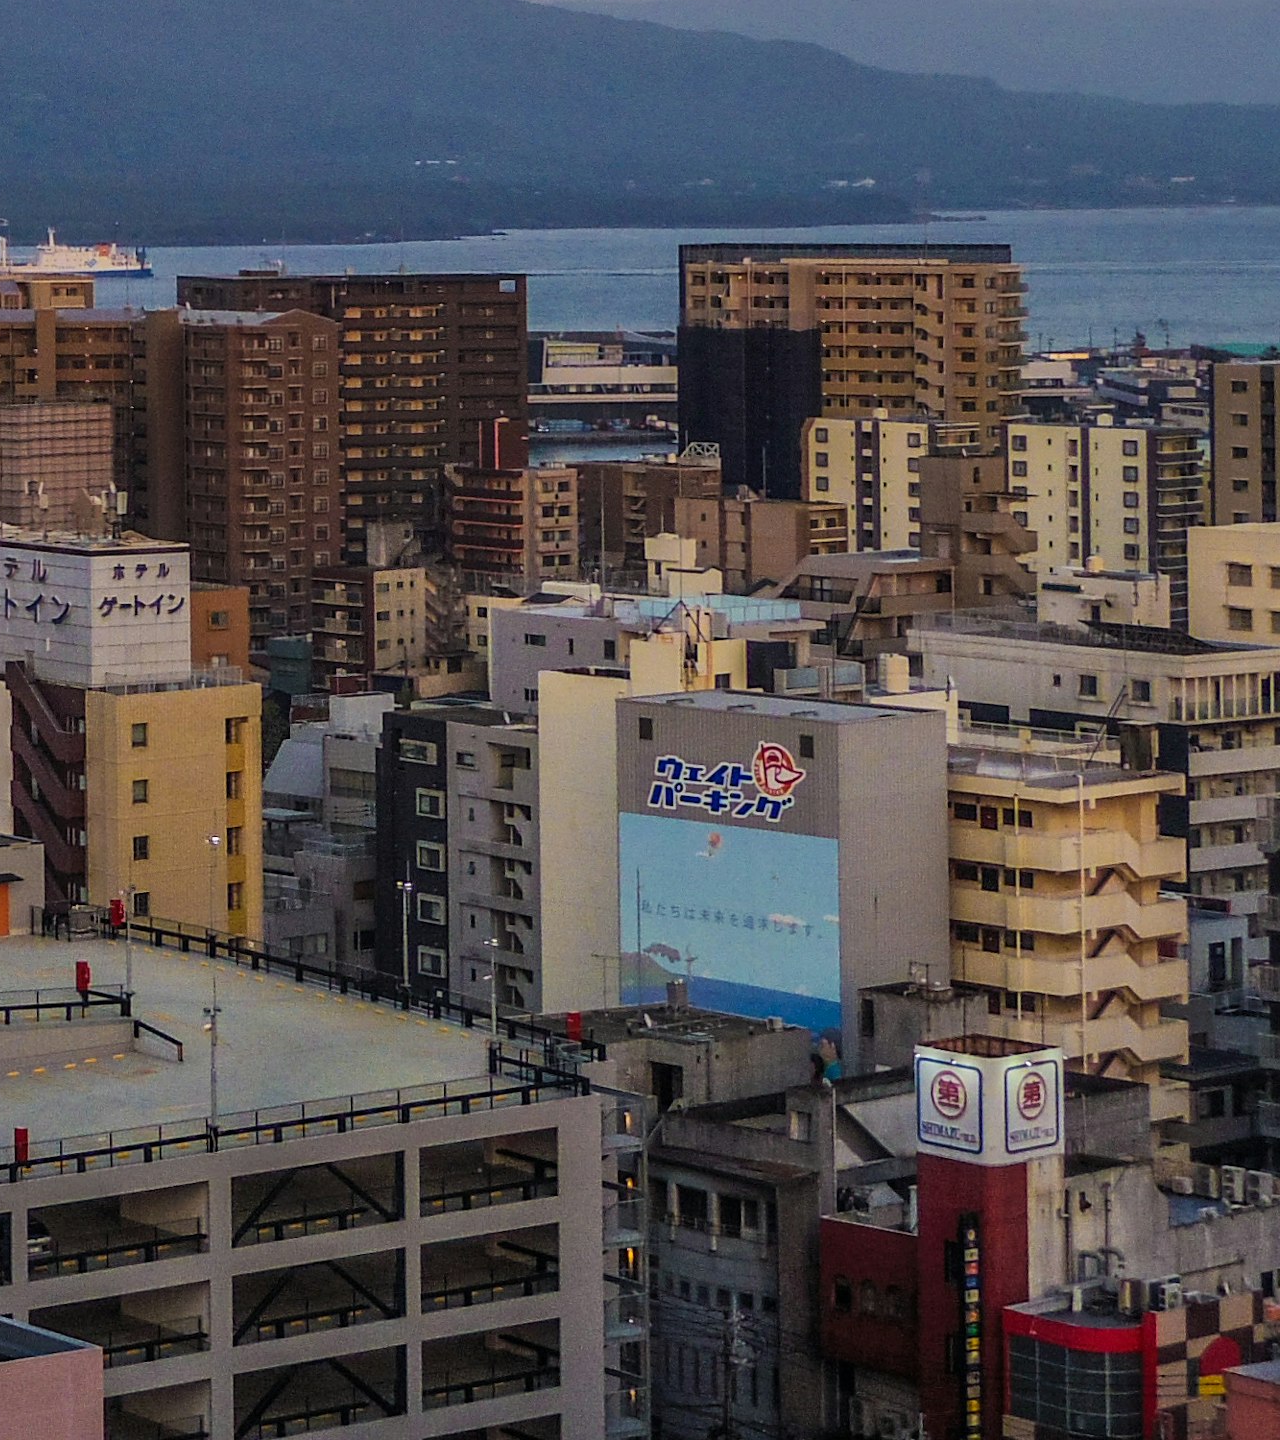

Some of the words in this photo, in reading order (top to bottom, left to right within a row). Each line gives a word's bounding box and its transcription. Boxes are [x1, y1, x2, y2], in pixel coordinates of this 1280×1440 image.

[112, 563, 170, 580] ホテル
[99, 593, 185, 617] ゲートイン
[656, 756, 753, 788] ウェイト
[648, 782, 795, 822] パーキング
